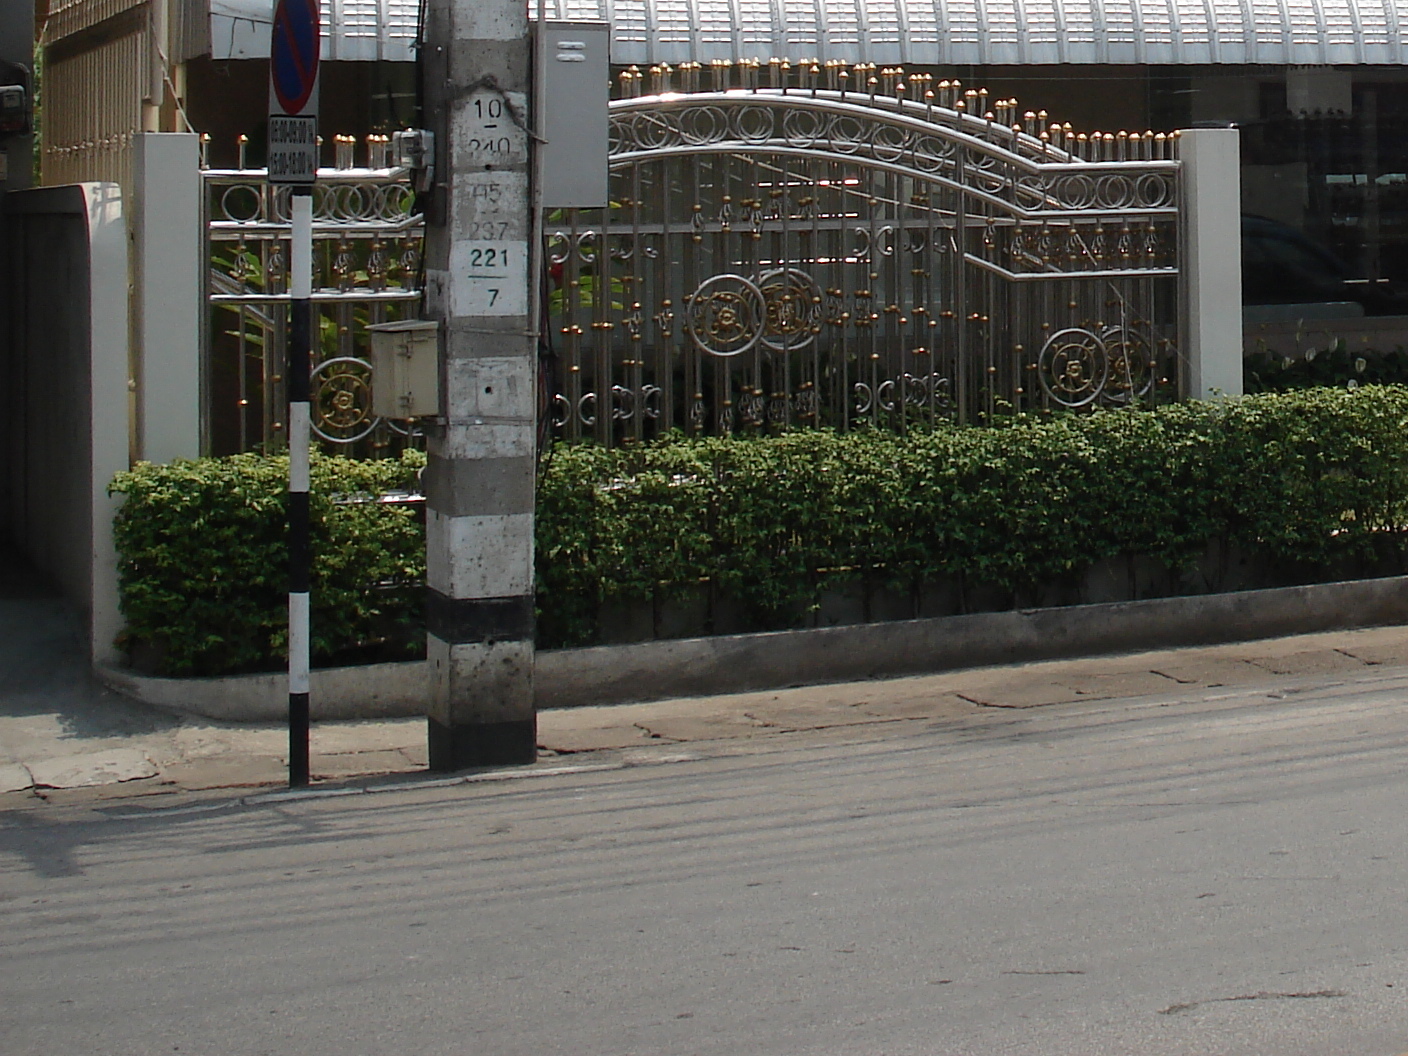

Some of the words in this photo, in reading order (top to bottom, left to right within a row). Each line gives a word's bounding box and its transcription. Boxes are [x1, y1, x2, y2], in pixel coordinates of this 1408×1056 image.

[474, 98, 502, 119] 10
[470, 248, 508, 267] 221
[487, 288, 500, 308] 7
